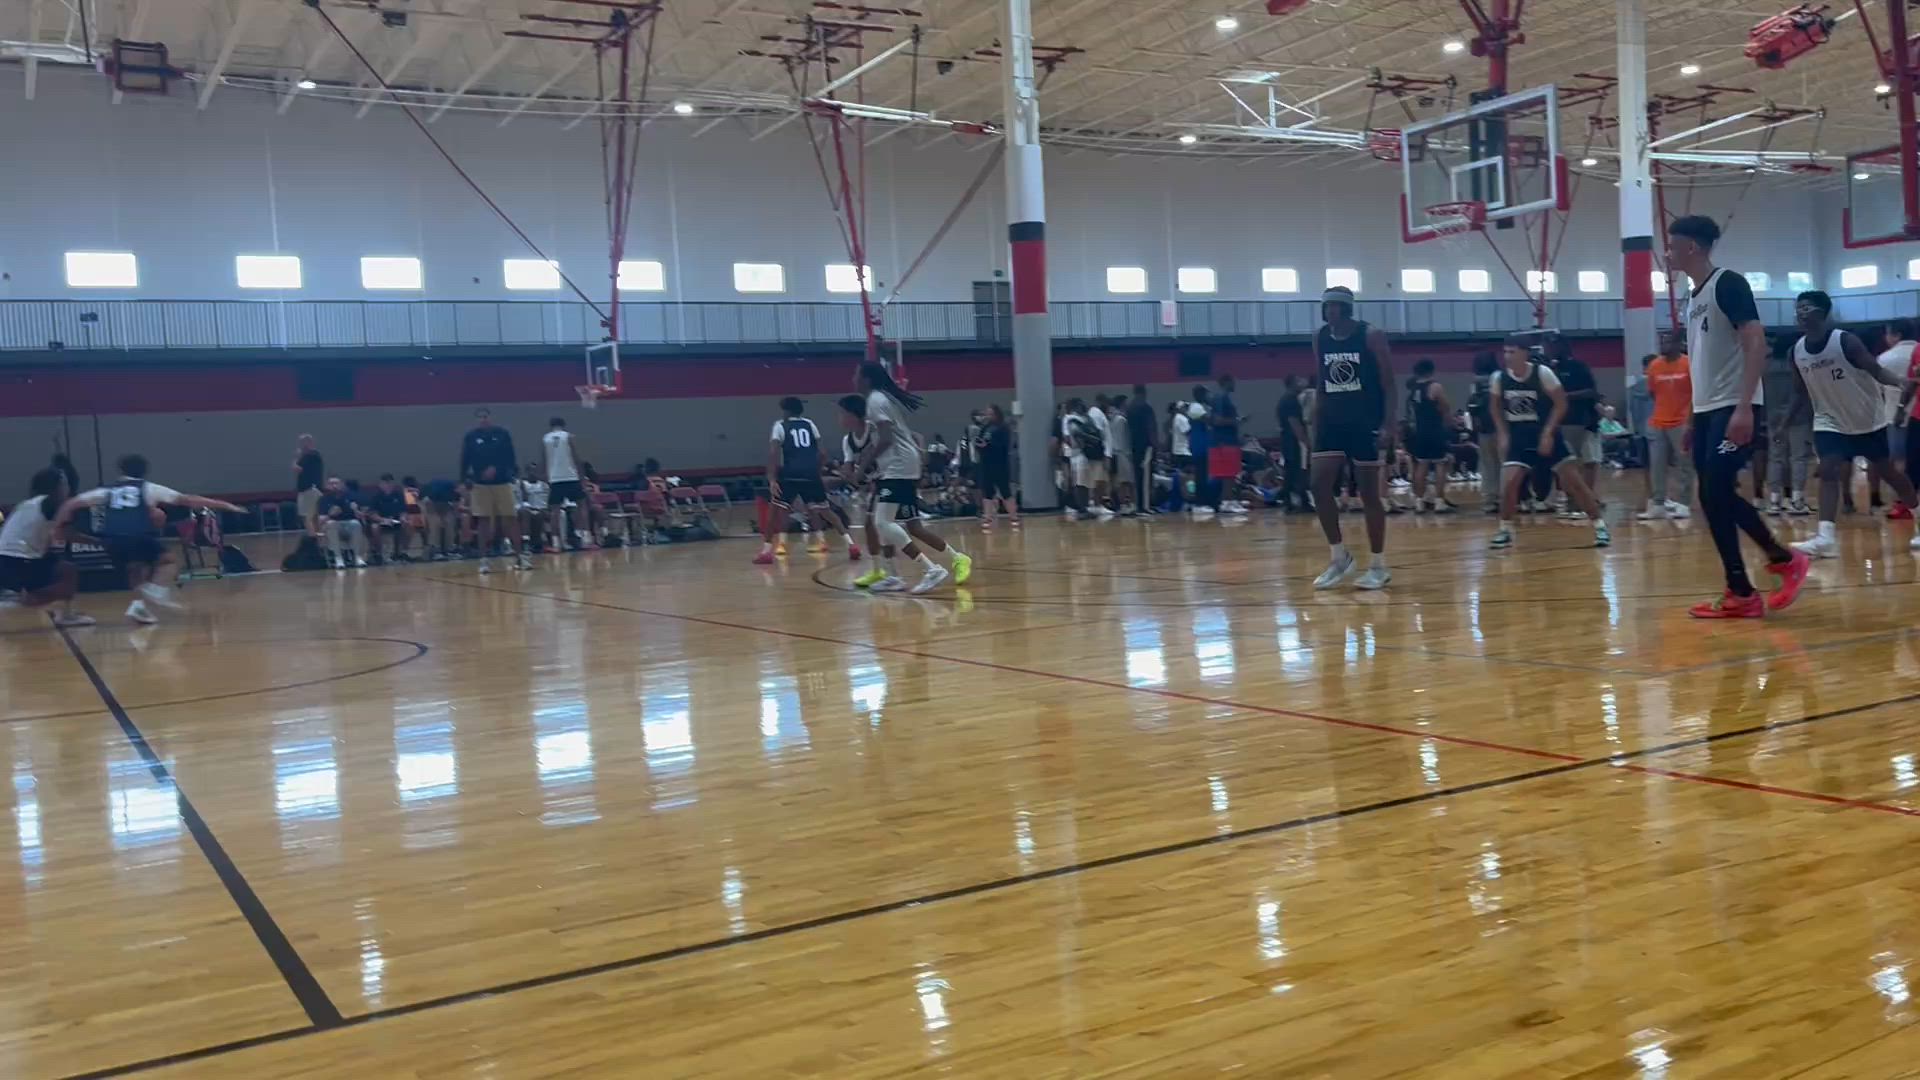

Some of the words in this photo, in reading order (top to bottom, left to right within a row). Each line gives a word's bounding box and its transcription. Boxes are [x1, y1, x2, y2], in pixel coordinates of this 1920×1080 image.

[1701, 316, 1709, 333] 4
[1832, 367, 1846, 381] 12
[790, 424, 812, 449] 10
